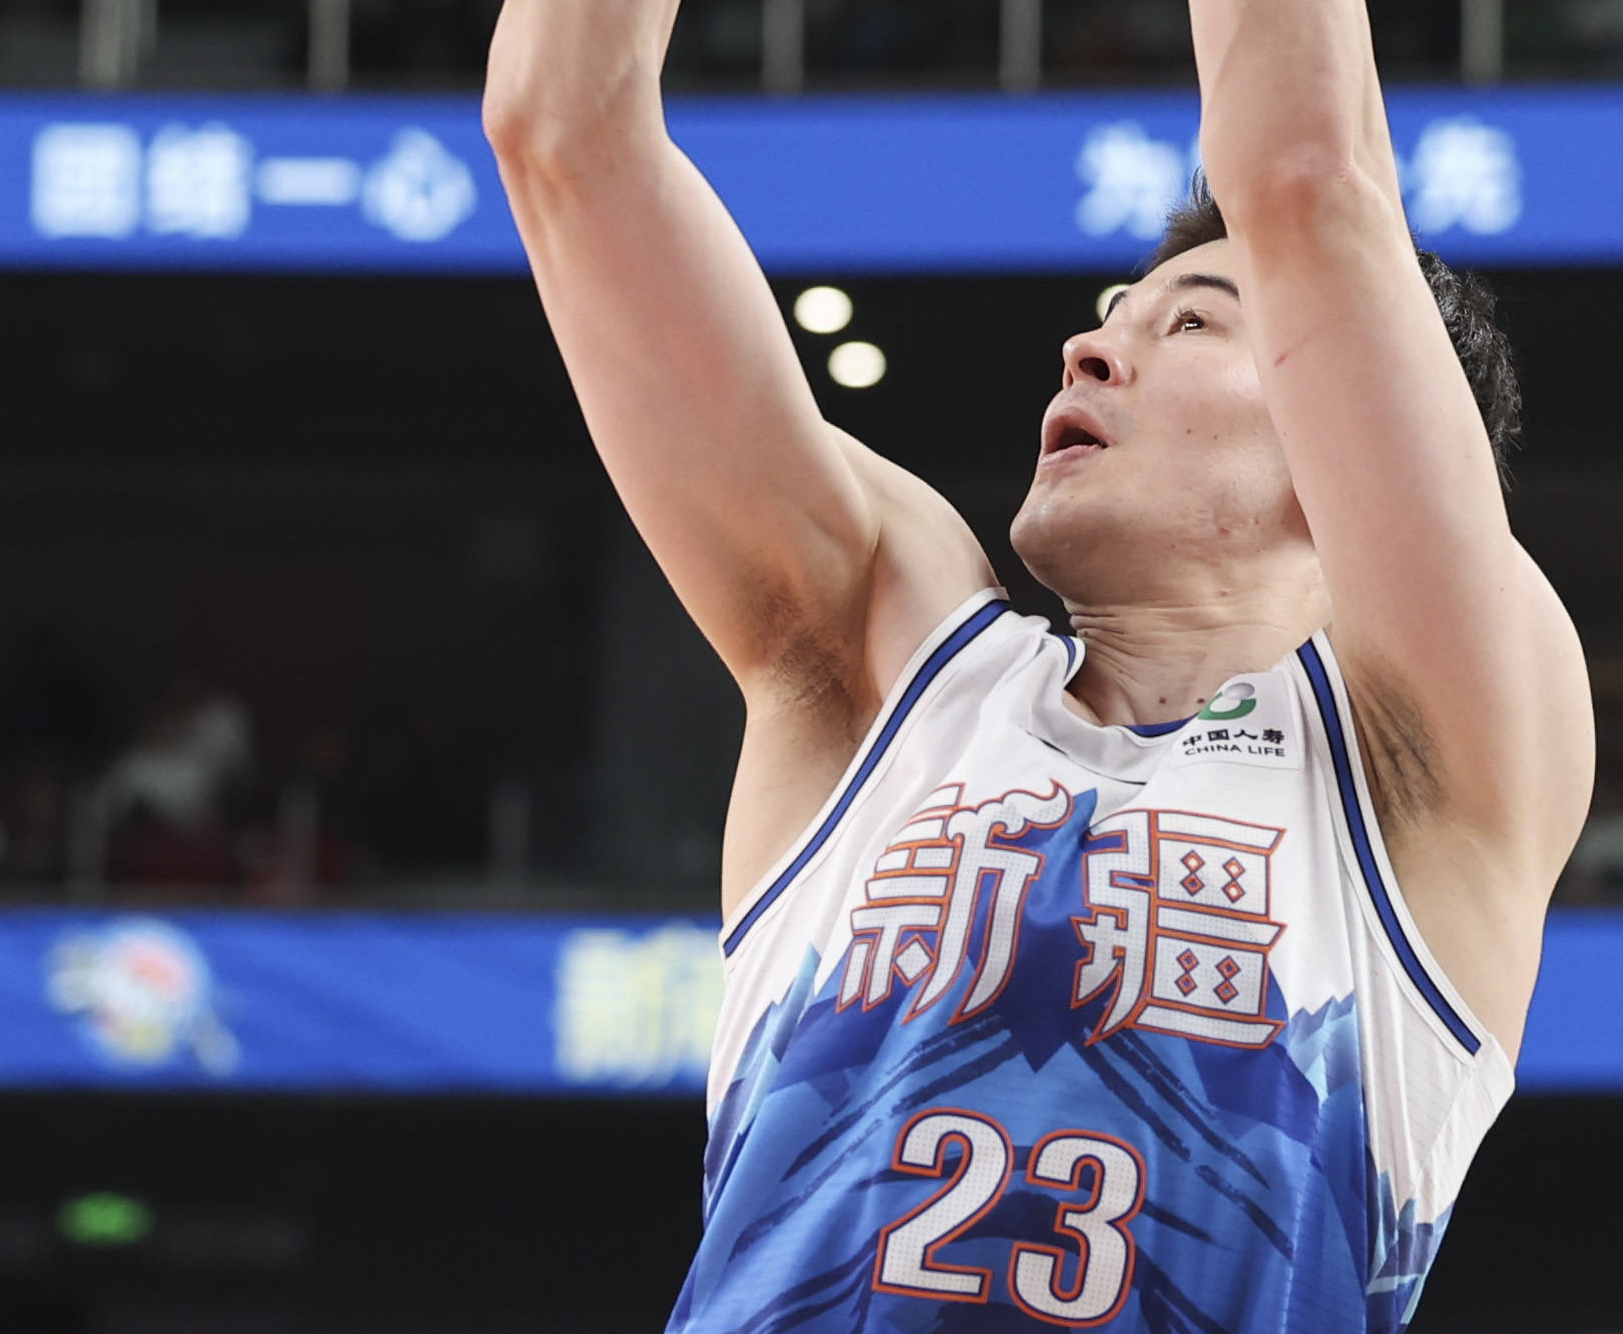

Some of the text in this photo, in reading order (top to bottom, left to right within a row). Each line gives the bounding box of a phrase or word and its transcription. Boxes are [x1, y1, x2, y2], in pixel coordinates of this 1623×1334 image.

[1184, 744, 1286, 758] CHINA LIFE
[871, 1105, 1148, 1330] 23
